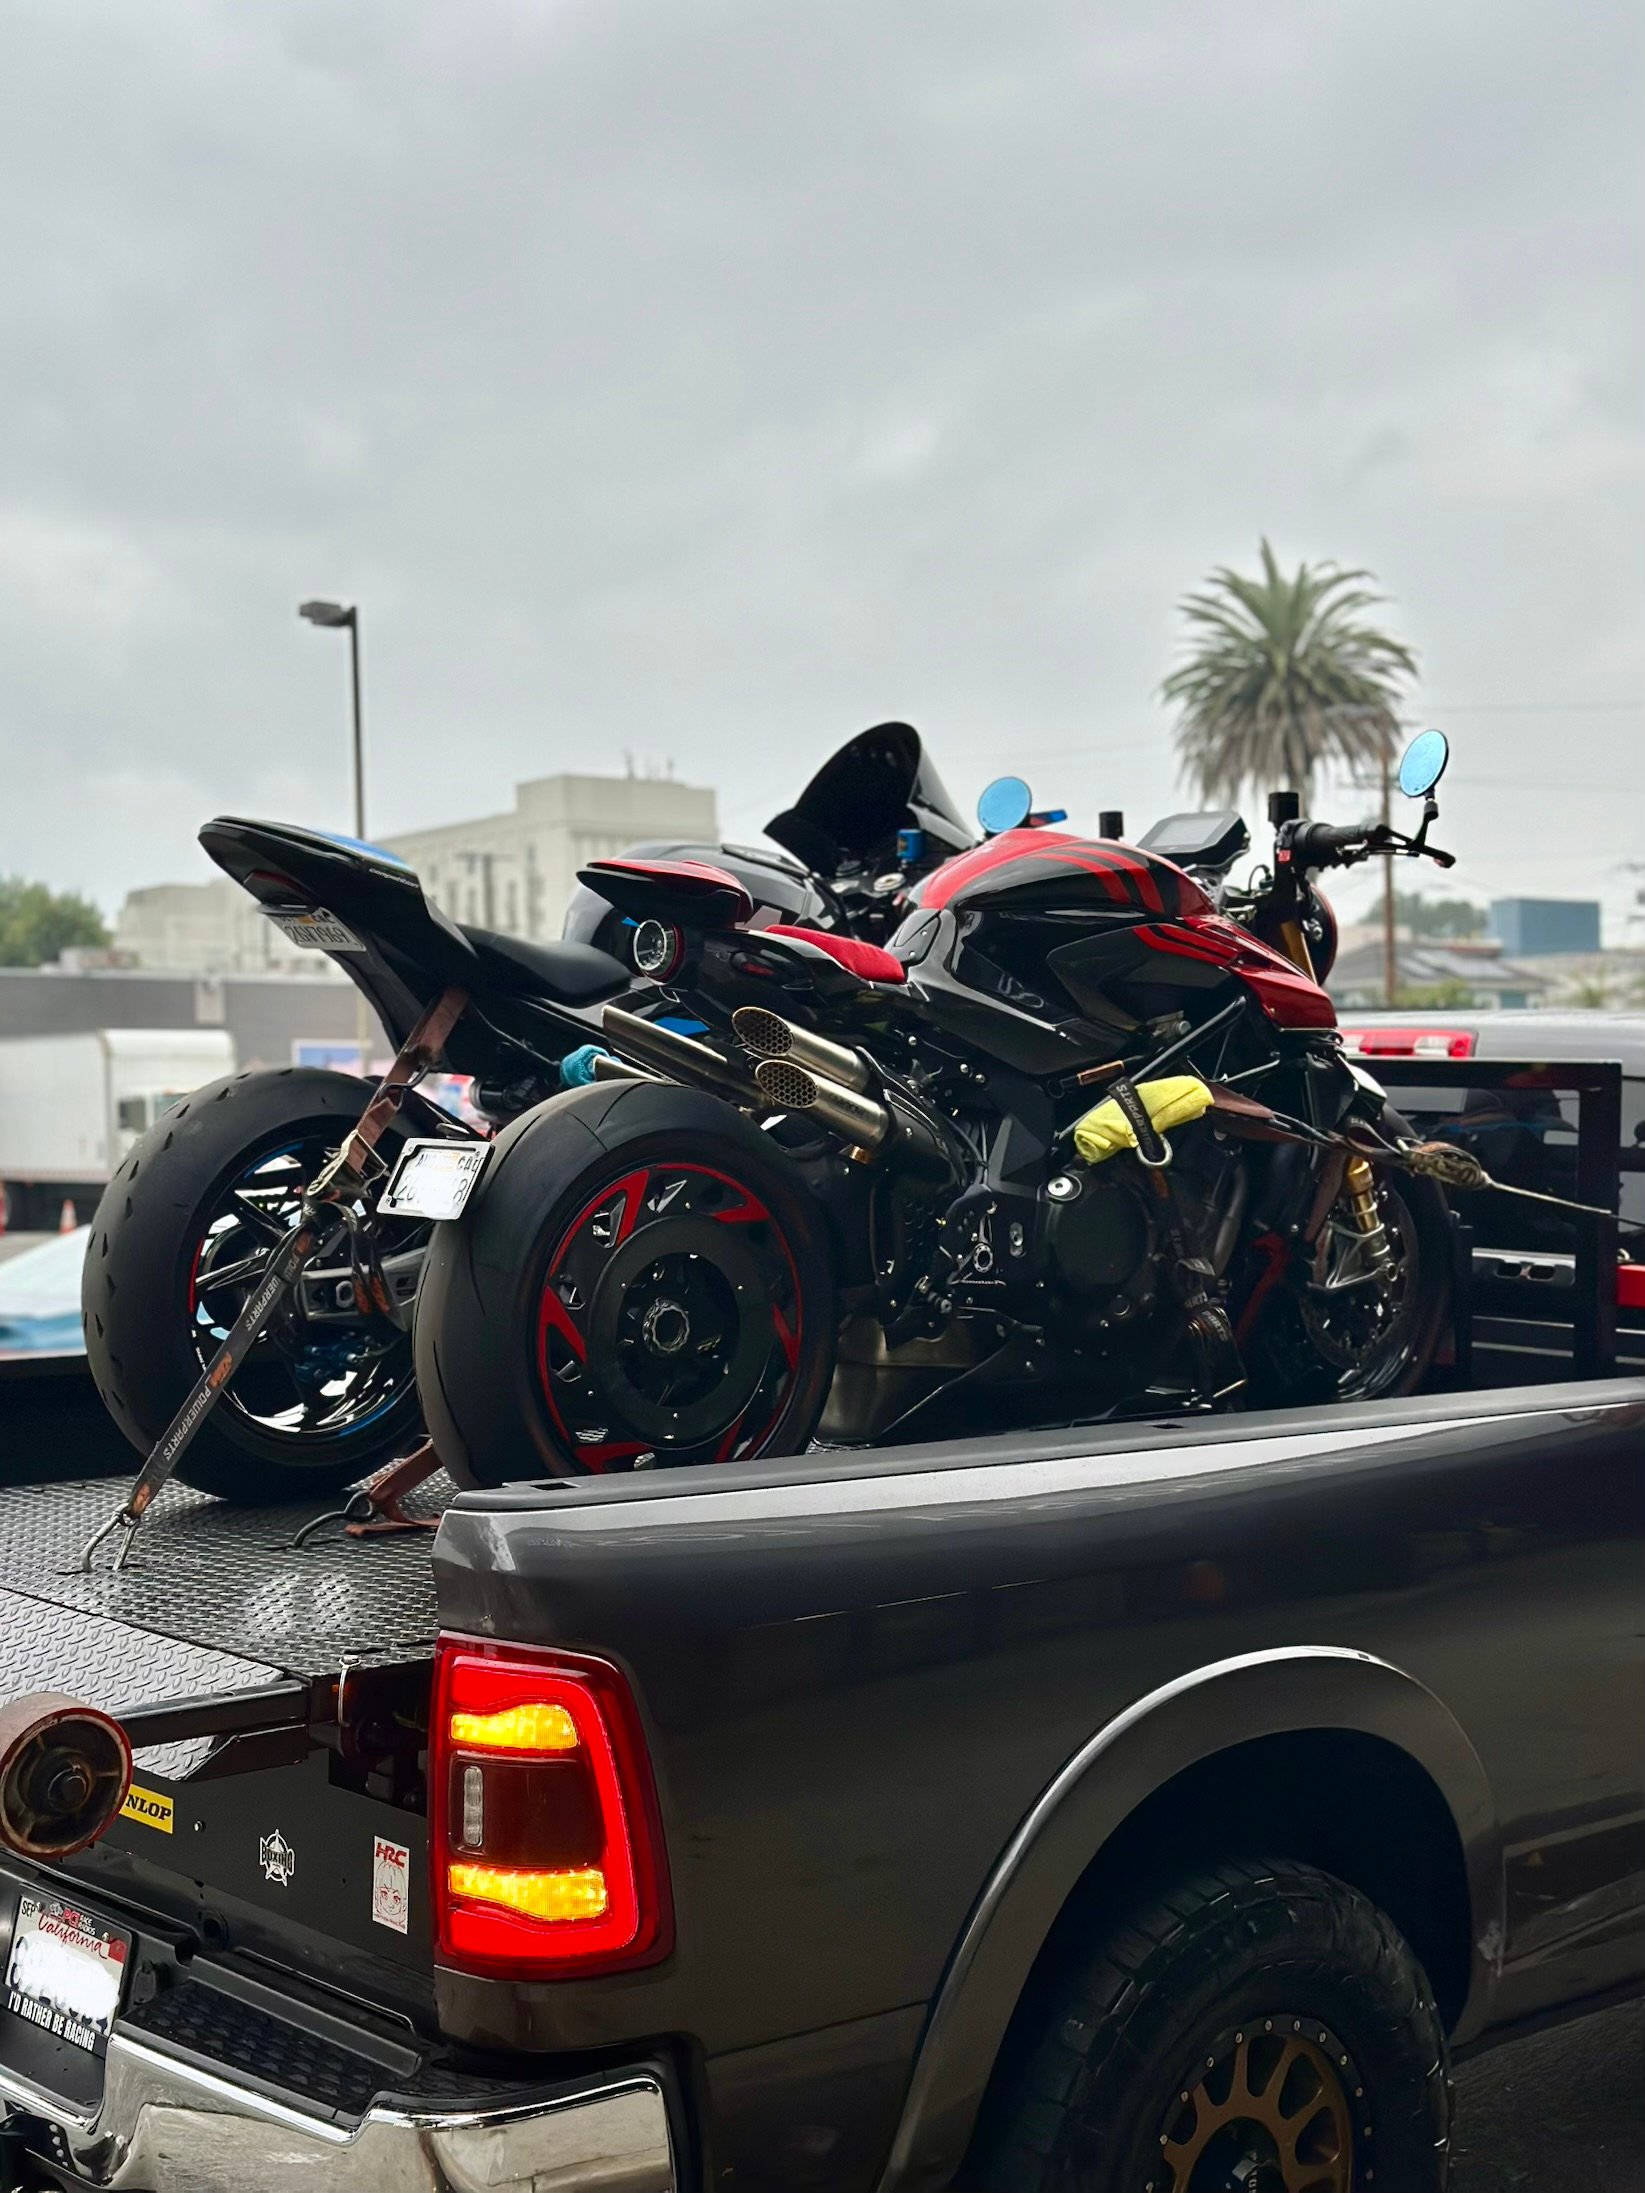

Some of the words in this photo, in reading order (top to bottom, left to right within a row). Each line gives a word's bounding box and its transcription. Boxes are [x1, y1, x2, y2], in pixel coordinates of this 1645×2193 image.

[162, 1384, 212, 1461] POWERPARTS
[125, 1793, 172, 1821] NLOP
[375, 1842, 407, 1868] HRC
[21, 1900, 36, 1918] SEP
[38, 1914, 108, 1960] California
[8, 1990, 21, 2012] I'D
[21, 1997, 52, 2029] RATHER
[52, 2013, 65, 2036] BE
[64, 2021, 97, 2052] RACING
